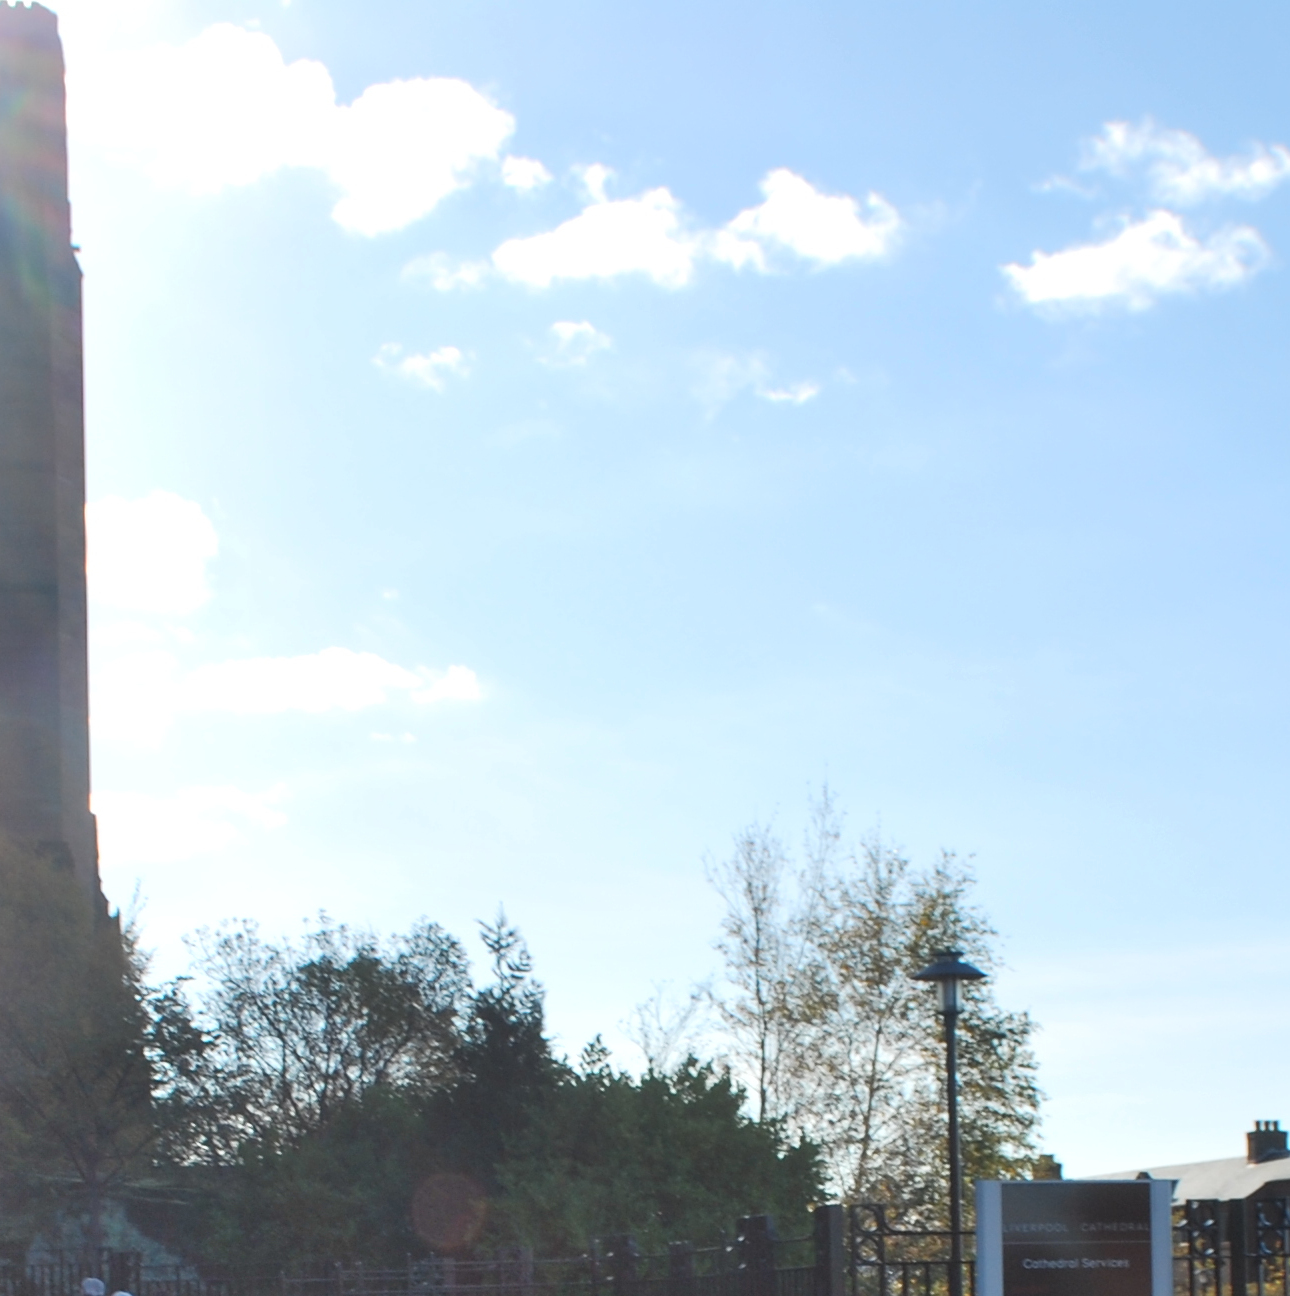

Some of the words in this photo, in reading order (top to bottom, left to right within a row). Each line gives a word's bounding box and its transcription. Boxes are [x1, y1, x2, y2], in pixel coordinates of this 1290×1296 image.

[1003, 1223, 1069, 1232] LIVERPOOL
[1081, 1222, 1150, 1232] CATHEDRAL
[1022, 1258, 1079, 1269] Cathedral
[1081, 1257, 1130, 1269] Services
